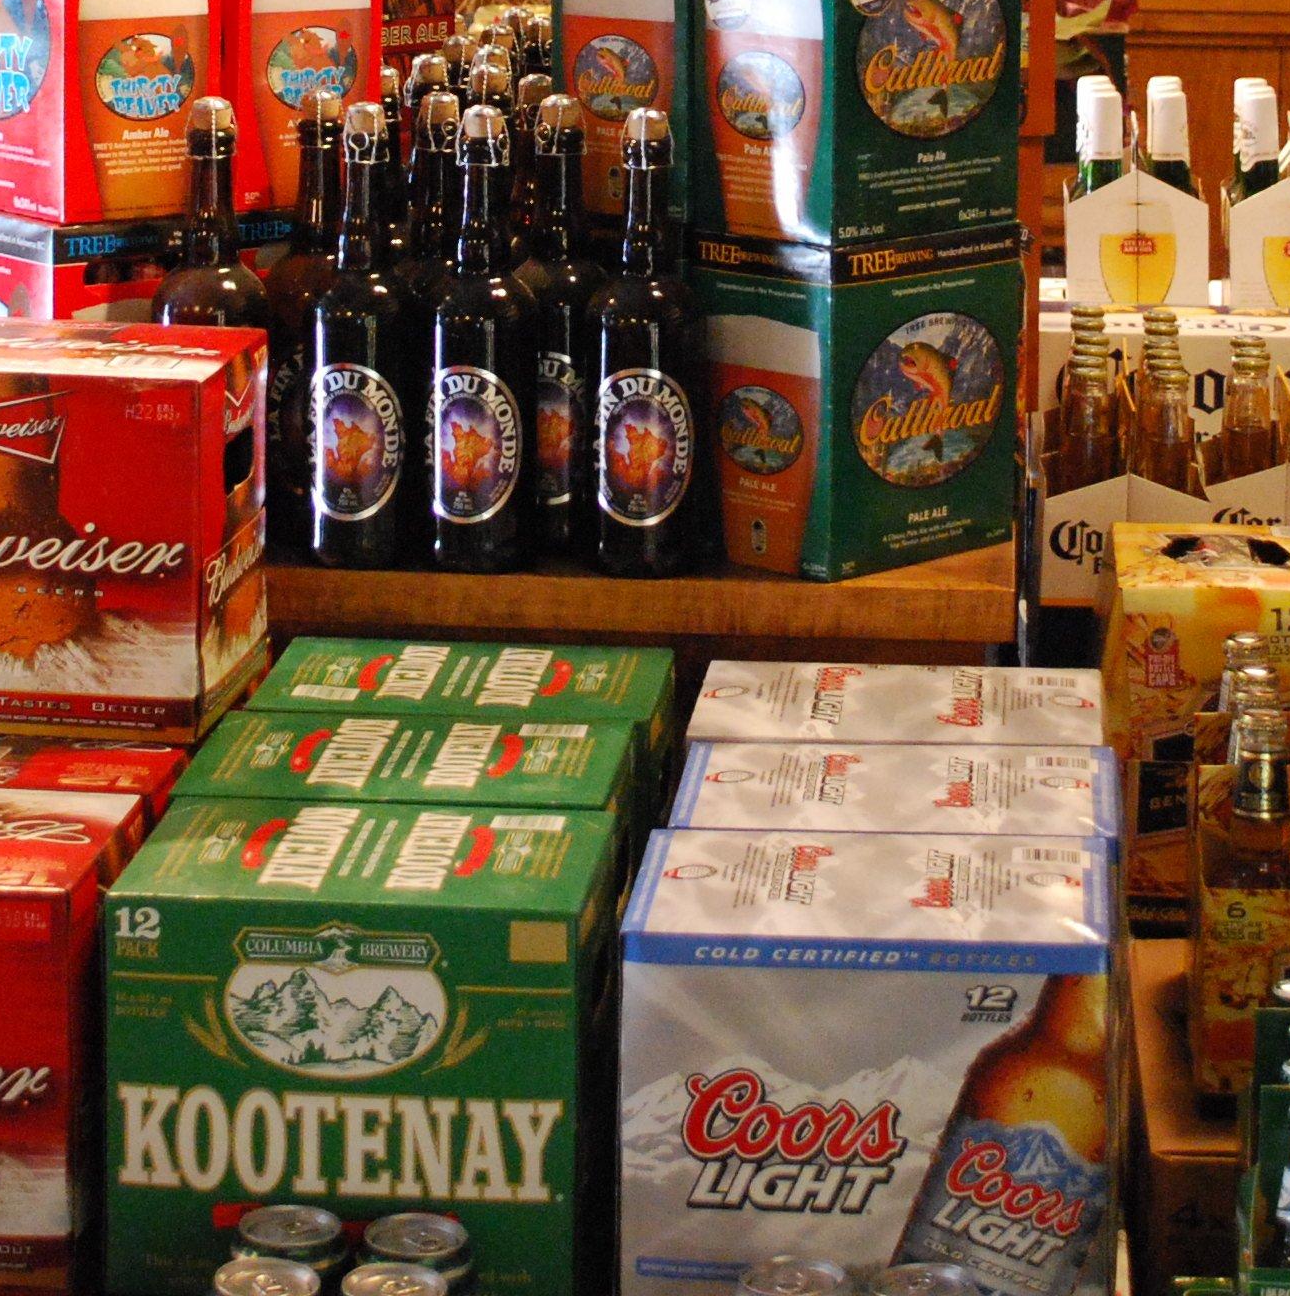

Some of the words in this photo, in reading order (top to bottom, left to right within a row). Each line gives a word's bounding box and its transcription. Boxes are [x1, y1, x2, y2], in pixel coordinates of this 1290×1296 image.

[416, 21, 449, 42] ALE
[281, 66, 346, 87] THIRSTY
[864, 42, 1005, 94] Cutthroat
[110, 74, 182, 96] THIRSTY
[112, 92, 183, 117] BEAVER
[122, 129, 152, 140] Amber
[153, 127, 170, 138] Ale
[65, 234, 116, 257] TREE
[699, 240, 741, 264] TREE
[848, 249, 896, 276] TREE
[895, 248, 934, 265] BREWING
[325, 371, 361, 394] DU
[360, 379, 399, 469] MONDE
[447, 374, 479, 396] DU
[482, 382, 518, 474] MONDE
[618, 377, 655, 399] DU
[657, 384, 691, 476] MONDE
[860, 384, 1003, 446] Cutthroat
[739, 475, 760, 489] PALE
[761, 480, 778, 493] ALE
[908, 508, 930, 524] PALE
[931, 505, 949, 518] ALE
[91, 701, 167, 716] BETTER
[114, 907, 161, 939] 12
[1226, 903, 1247, 920] 6
[245, 939, 323, 955] COLUMBIA
[360, 942, 430, 960] BREWERY
[694, 945, 761, 962] COLD
[966, 984, 1016, 1013] 12
[961, 1012, 1012, 1024] BOTTLES
[681, 1067, 909, 1164] Coors
[115, 1081, 564, 1203] KOOTENAY
[685, 1161, 891, 1214] LIGHT
[946, 1137, 1085, 1235] Coors
[932, 1196, 1068, 1266] LIGHT
